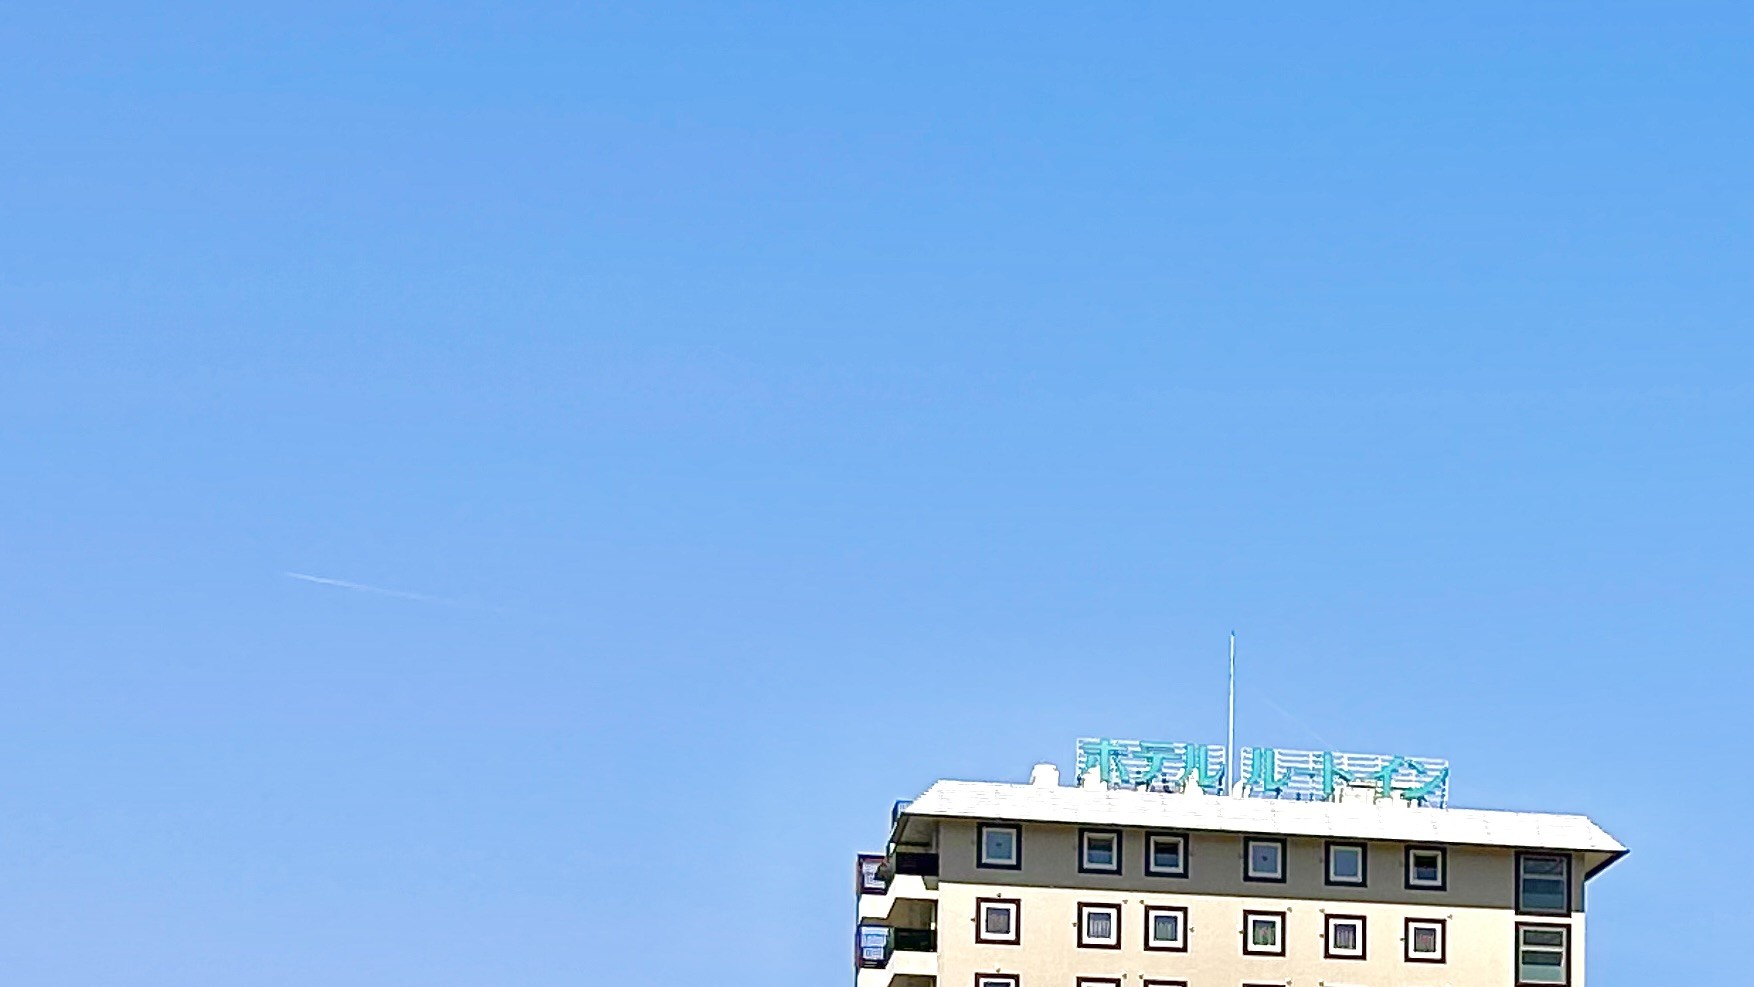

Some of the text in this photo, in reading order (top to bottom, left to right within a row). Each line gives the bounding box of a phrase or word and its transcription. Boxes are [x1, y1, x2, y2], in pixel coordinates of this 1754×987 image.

[1081, 738, 1449, 799] ホテル ルートイン
